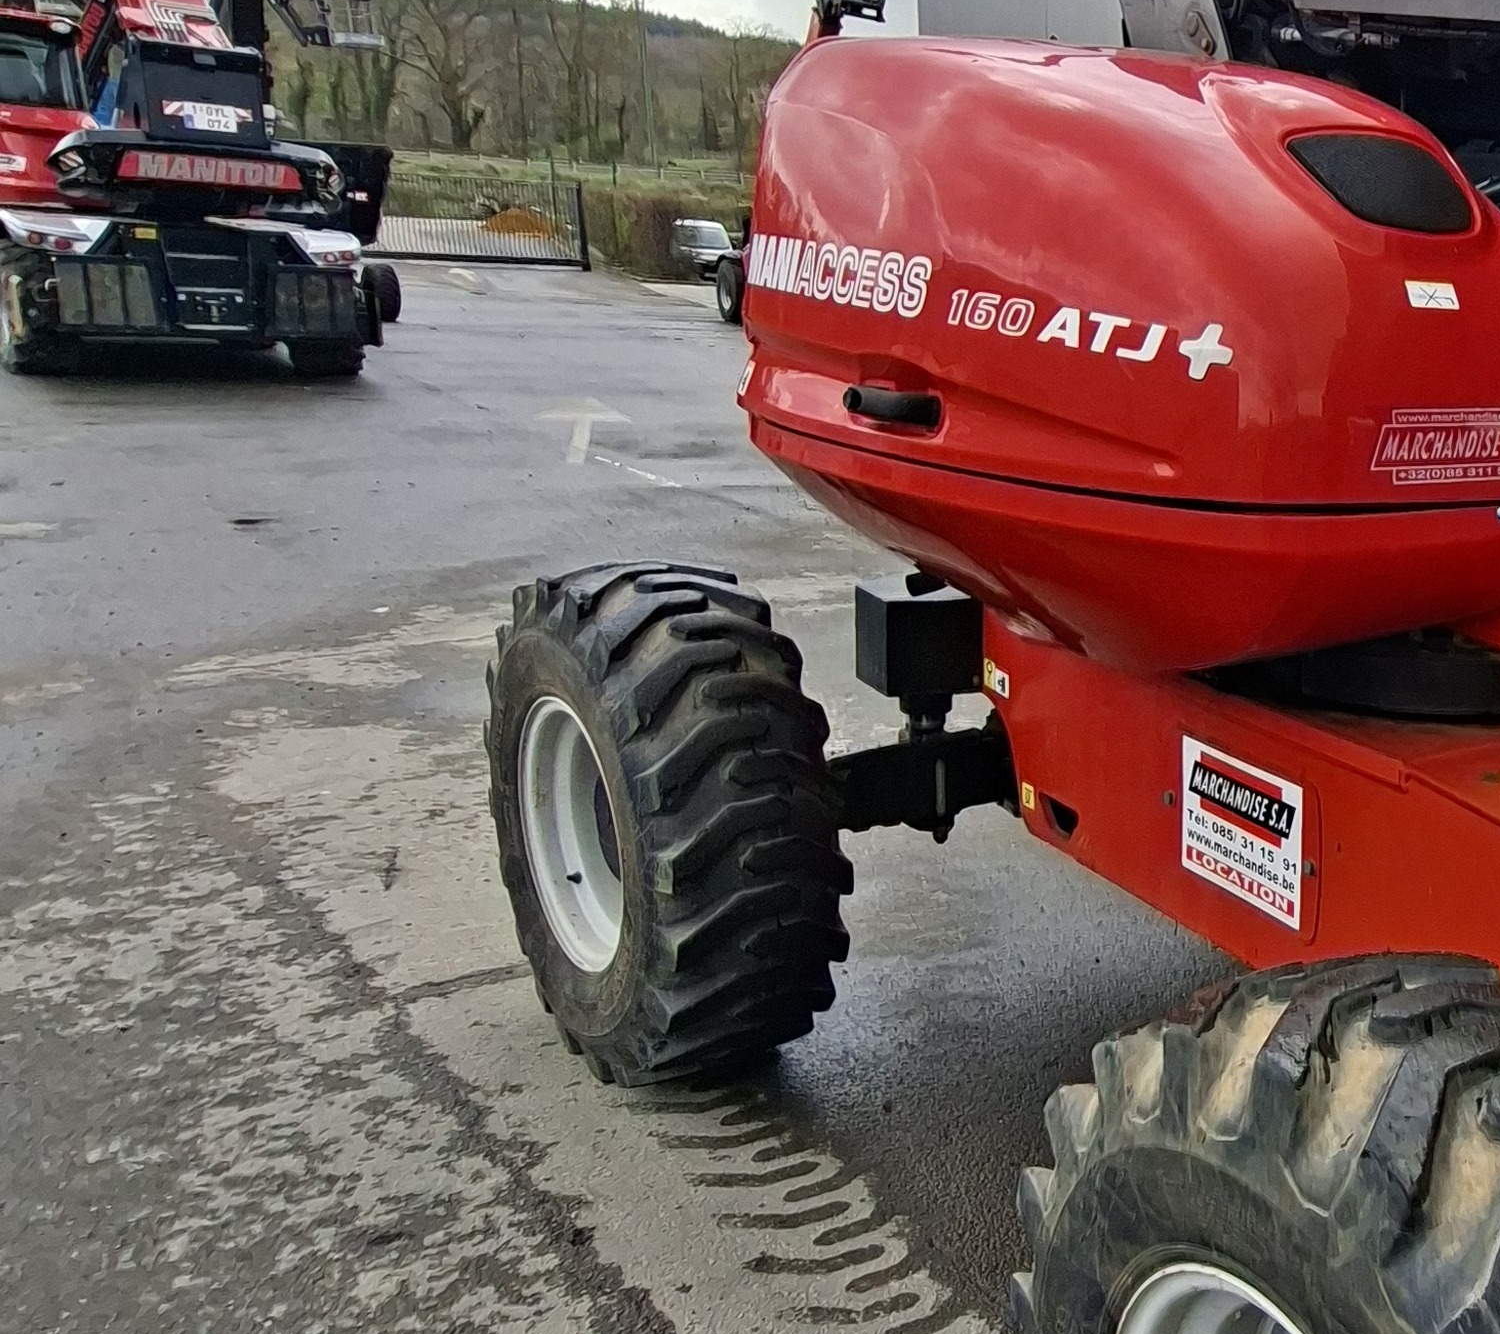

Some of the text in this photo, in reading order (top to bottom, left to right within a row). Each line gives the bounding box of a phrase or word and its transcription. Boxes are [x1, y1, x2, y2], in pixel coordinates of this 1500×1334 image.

[137, 153, 284, 188] MANITOU
[747, 233, 932, 317] MANIACCESS
[947, 289, 1035, 337] 160
[1037, 307, 1168, 363] ATJ
[1192, 766, 1290, 834] MARCHANDISE S.A.
[1187, 808, 1297, 876] Tél: 085/ 31 15 91
[1187, 827, 1295, 894] www.marchandise.be
[1191, 848, 1290, 914] LOCATION
